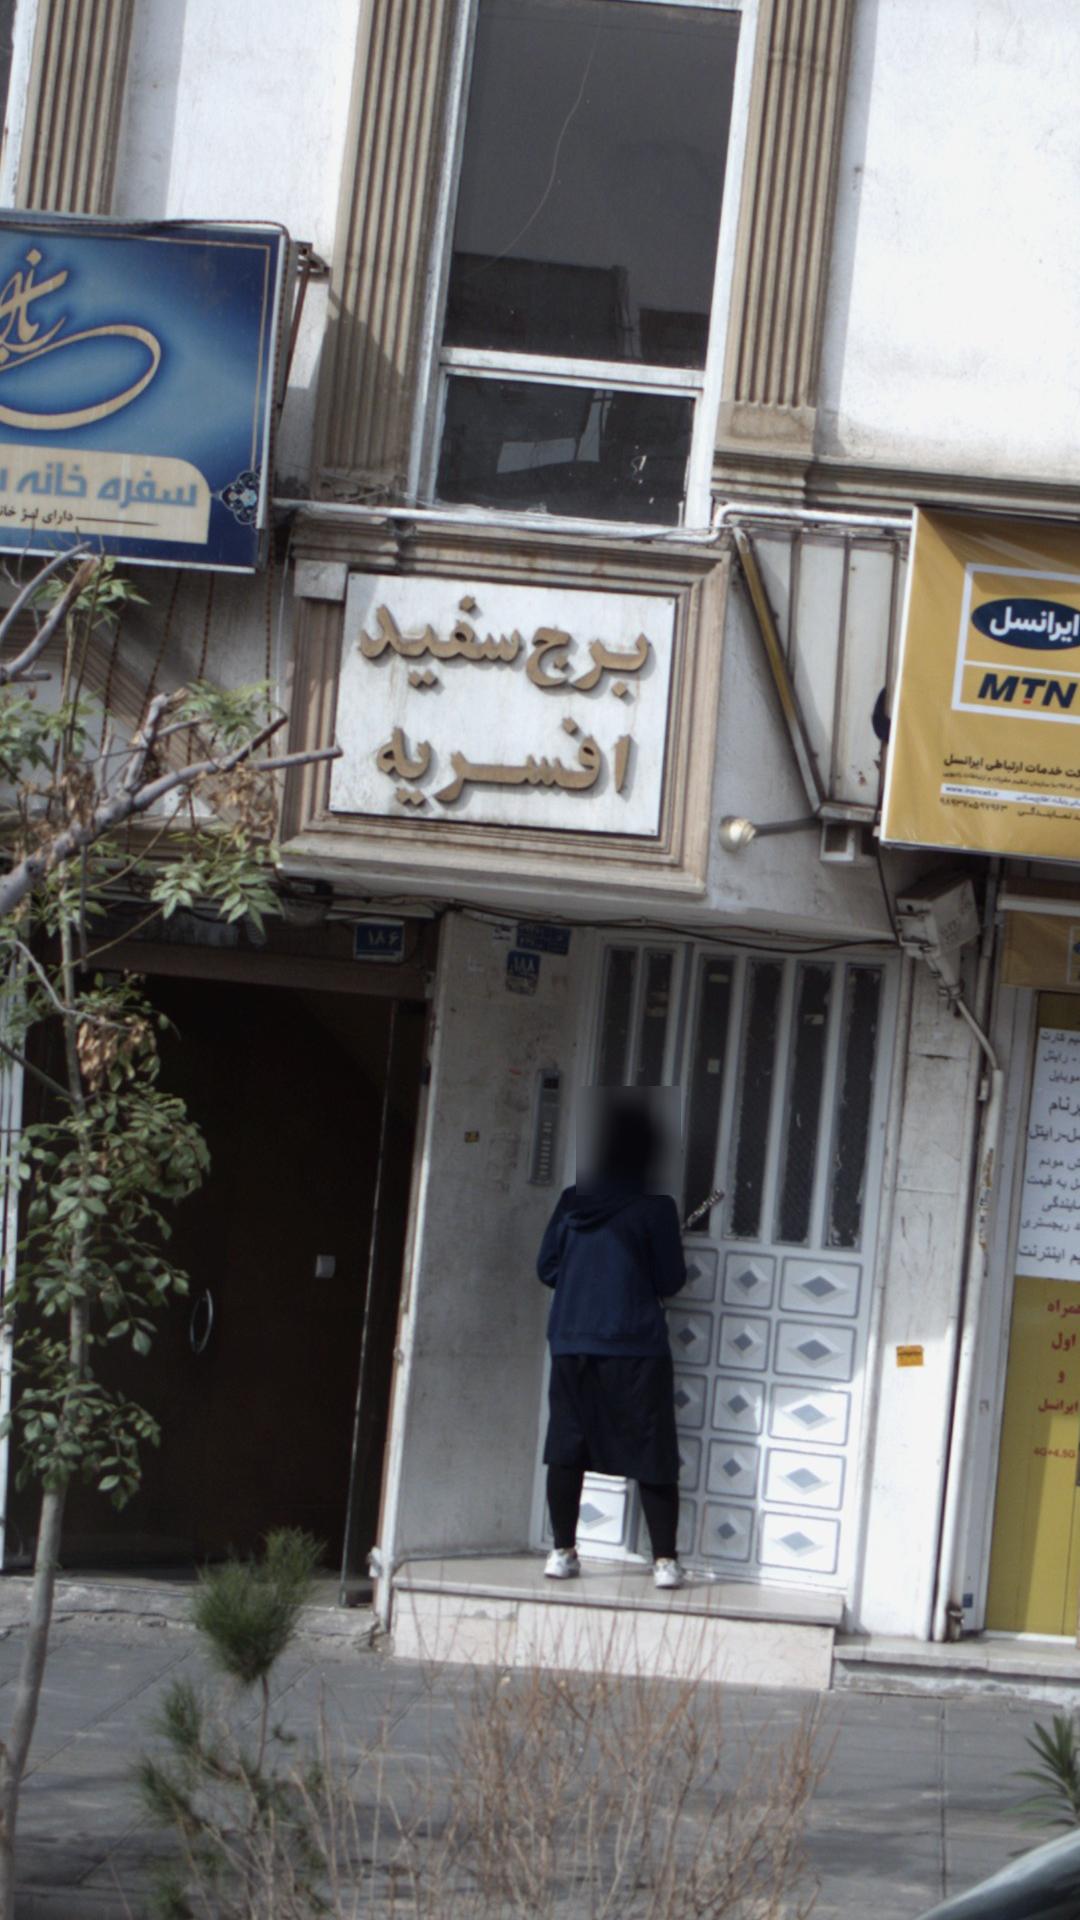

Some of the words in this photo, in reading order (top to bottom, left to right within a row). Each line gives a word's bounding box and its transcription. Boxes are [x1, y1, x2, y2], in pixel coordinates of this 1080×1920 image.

[16, 461, 87, 497] خانه
[97, 470, 197, 509] سفره
[41, 508, 73, 525] دارای
[358, 594, 523, 688] سفید
[989, 606, 1080, 642] ایرانسل
[526, 625, 651, 697] برج
[977, 672, 1078, 709] MTN
[376, 716, 632, 807] افسریه
[943, 753, 984, 769] ایرانسل
[985, 758, 1024, 774] ارتباطی
[1025, 763, 1063, 777] خدمات
[1051, 1332, 1077, 1351] اول
[1038, 1399, 1079, 1415] ایرانسل
